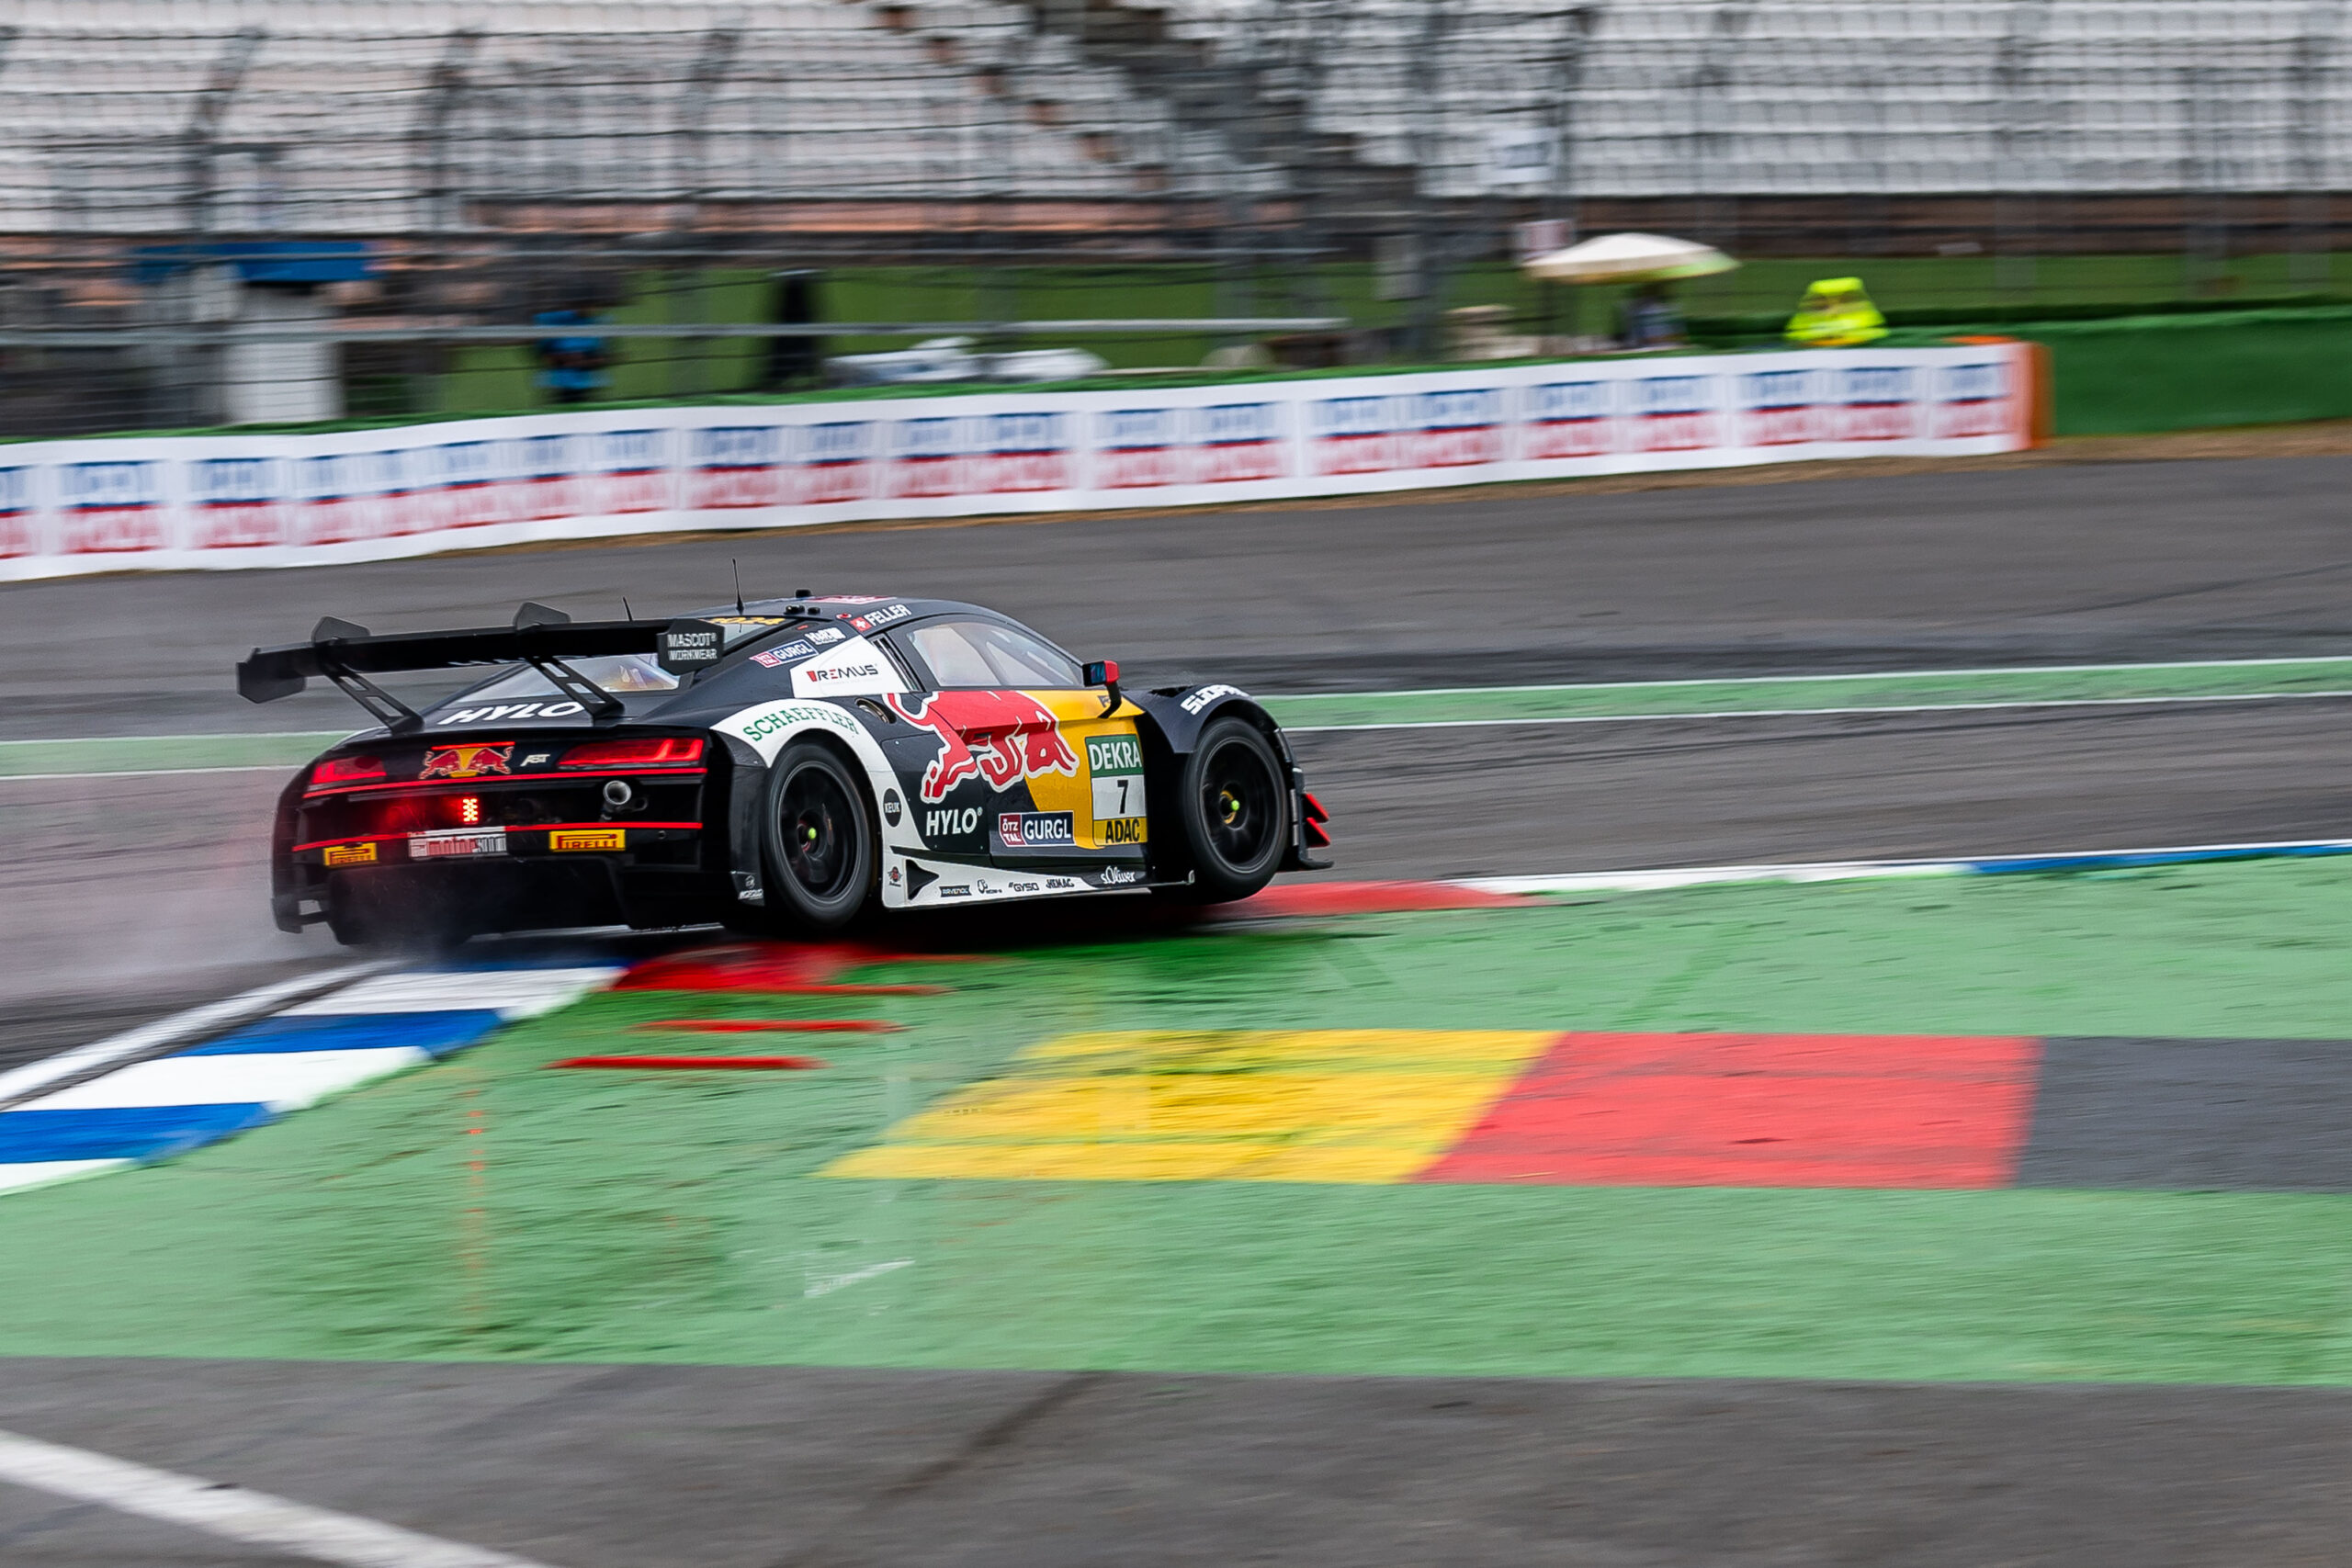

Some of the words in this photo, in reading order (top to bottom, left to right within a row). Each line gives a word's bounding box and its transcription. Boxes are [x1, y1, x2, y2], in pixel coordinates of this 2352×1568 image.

[864, 604, 912, 626] FELLER
[773, 644, 814, 660] GURGL
[817, 664, 879, 682] REMUS
[437, 702, 585, 726] HYLO
[742, 706, 860, 742] SCHAEFFLER
[1088, 740, 1143, 772] DEKRA
[1116, 779, 1129, 815] 7
[1001, 818, 1019, 832] ÖTZ
[1023, 818, 1071, 840] GURGL
[1105, 818, 1141, 844] ADAC
[556, 833, 618, 850] PIRELLI
[1002, 832, 1023, 842] TAL
